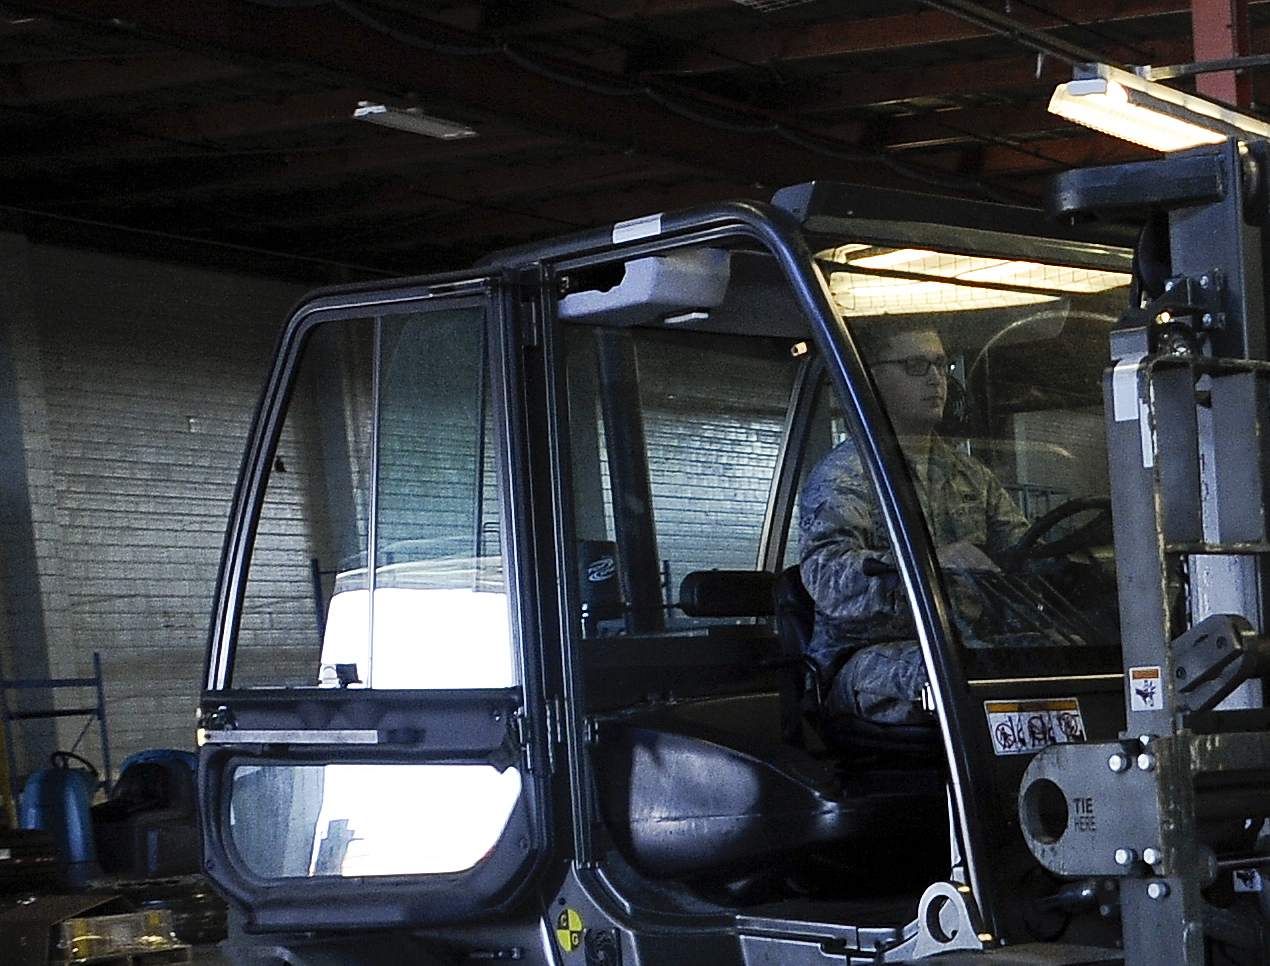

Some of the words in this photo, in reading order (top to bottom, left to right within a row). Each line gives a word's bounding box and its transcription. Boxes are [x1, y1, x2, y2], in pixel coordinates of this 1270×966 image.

[1073, 797, 1093, 814] TIE
[1074, 815, 1096, 832] HERE
[560, 914, 568, 927] C
[571, 932, 580, 946] G
